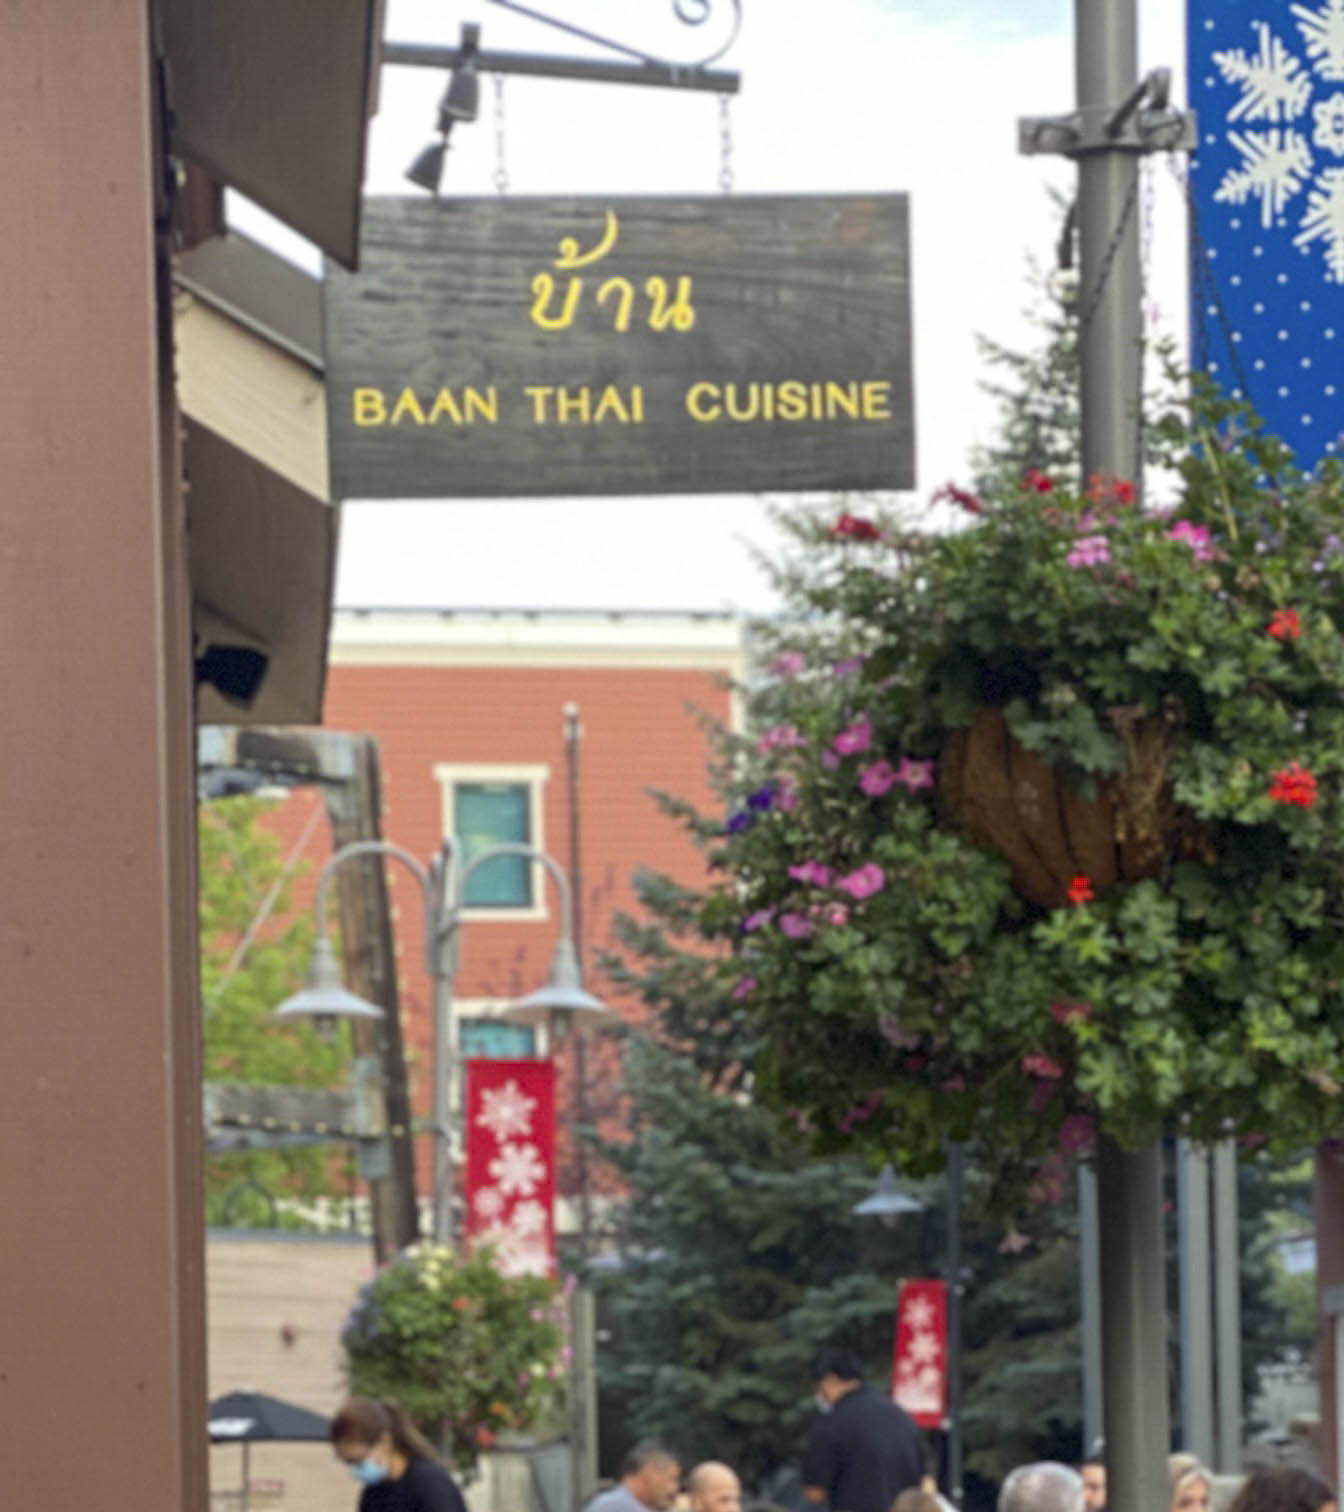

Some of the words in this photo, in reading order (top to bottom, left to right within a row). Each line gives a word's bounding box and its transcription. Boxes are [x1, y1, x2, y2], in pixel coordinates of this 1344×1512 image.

[530, 209, 695, 332] บ้าน
[352, 386, 497, 427] BAAN
[526, 384, 644, 424] THAI
[685, 381, 892, 423] CUISINE
